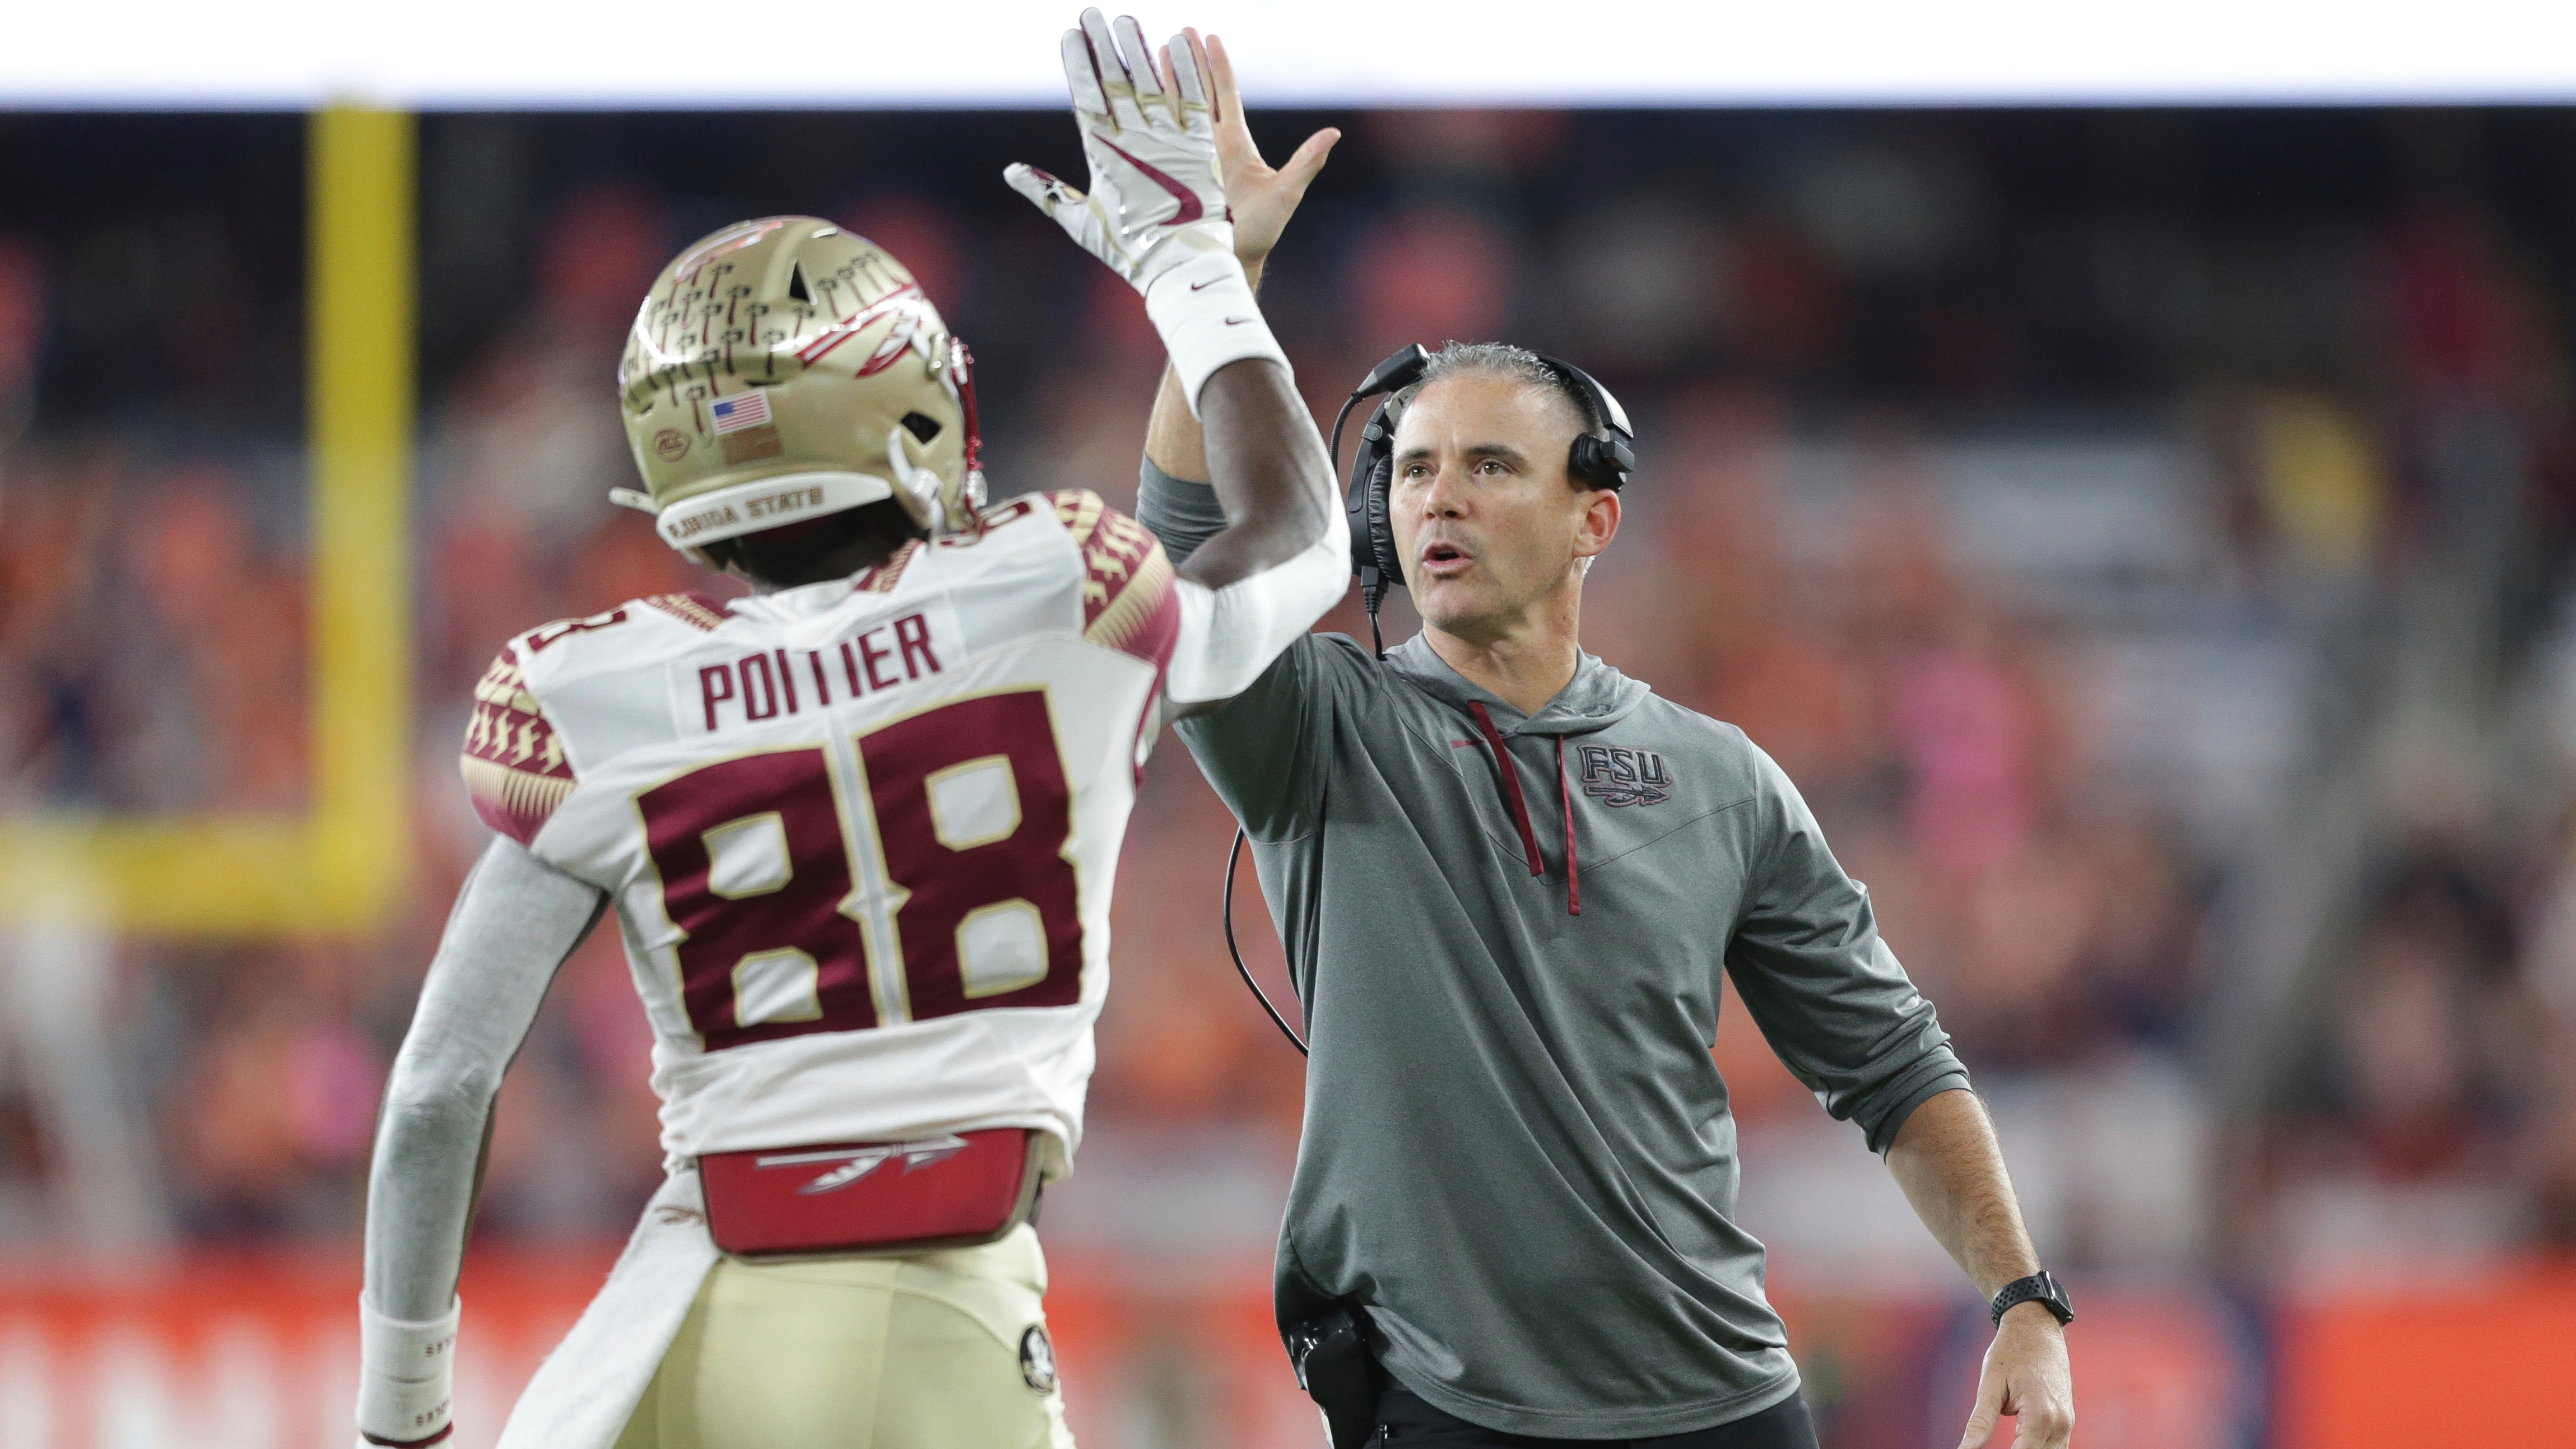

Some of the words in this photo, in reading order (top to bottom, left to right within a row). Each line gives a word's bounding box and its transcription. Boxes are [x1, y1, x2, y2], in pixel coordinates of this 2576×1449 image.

[746, 484, 824, 519] STATE
[699, 613, 942, 733] POITIER
[1577, 743, 1668, 788] FSU
[629, 682, 1086, 1055] 88
